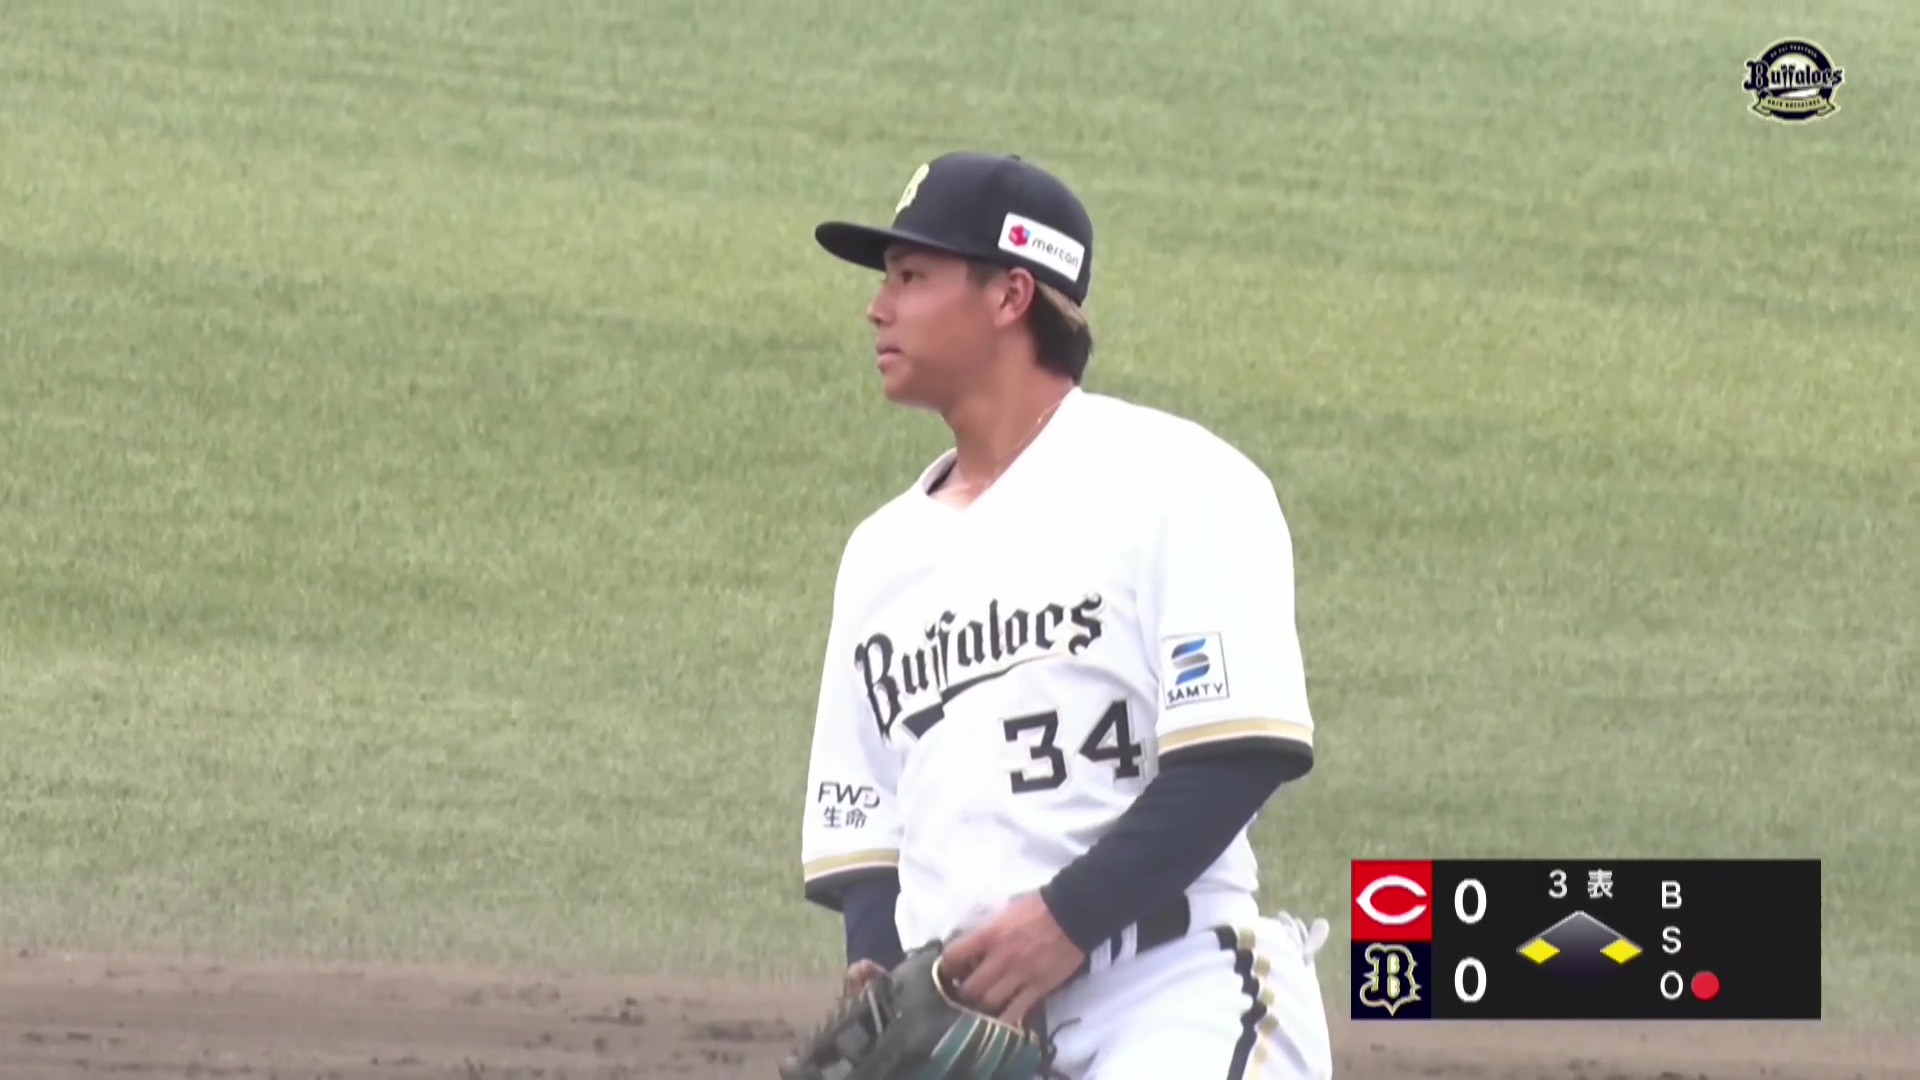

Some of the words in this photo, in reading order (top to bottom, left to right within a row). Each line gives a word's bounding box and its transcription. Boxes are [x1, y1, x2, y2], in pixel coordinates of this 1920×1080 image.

[1032, 236, 1080, 268] mercari
[854, 594, 1103, 744] Buffaloes
[1167, 682, 1224, 703] SAMTY
[1003, 699, 1144, 794] 34
[818, 781, 881, 809] FWD
[823, 806, 867, 829] 生命
